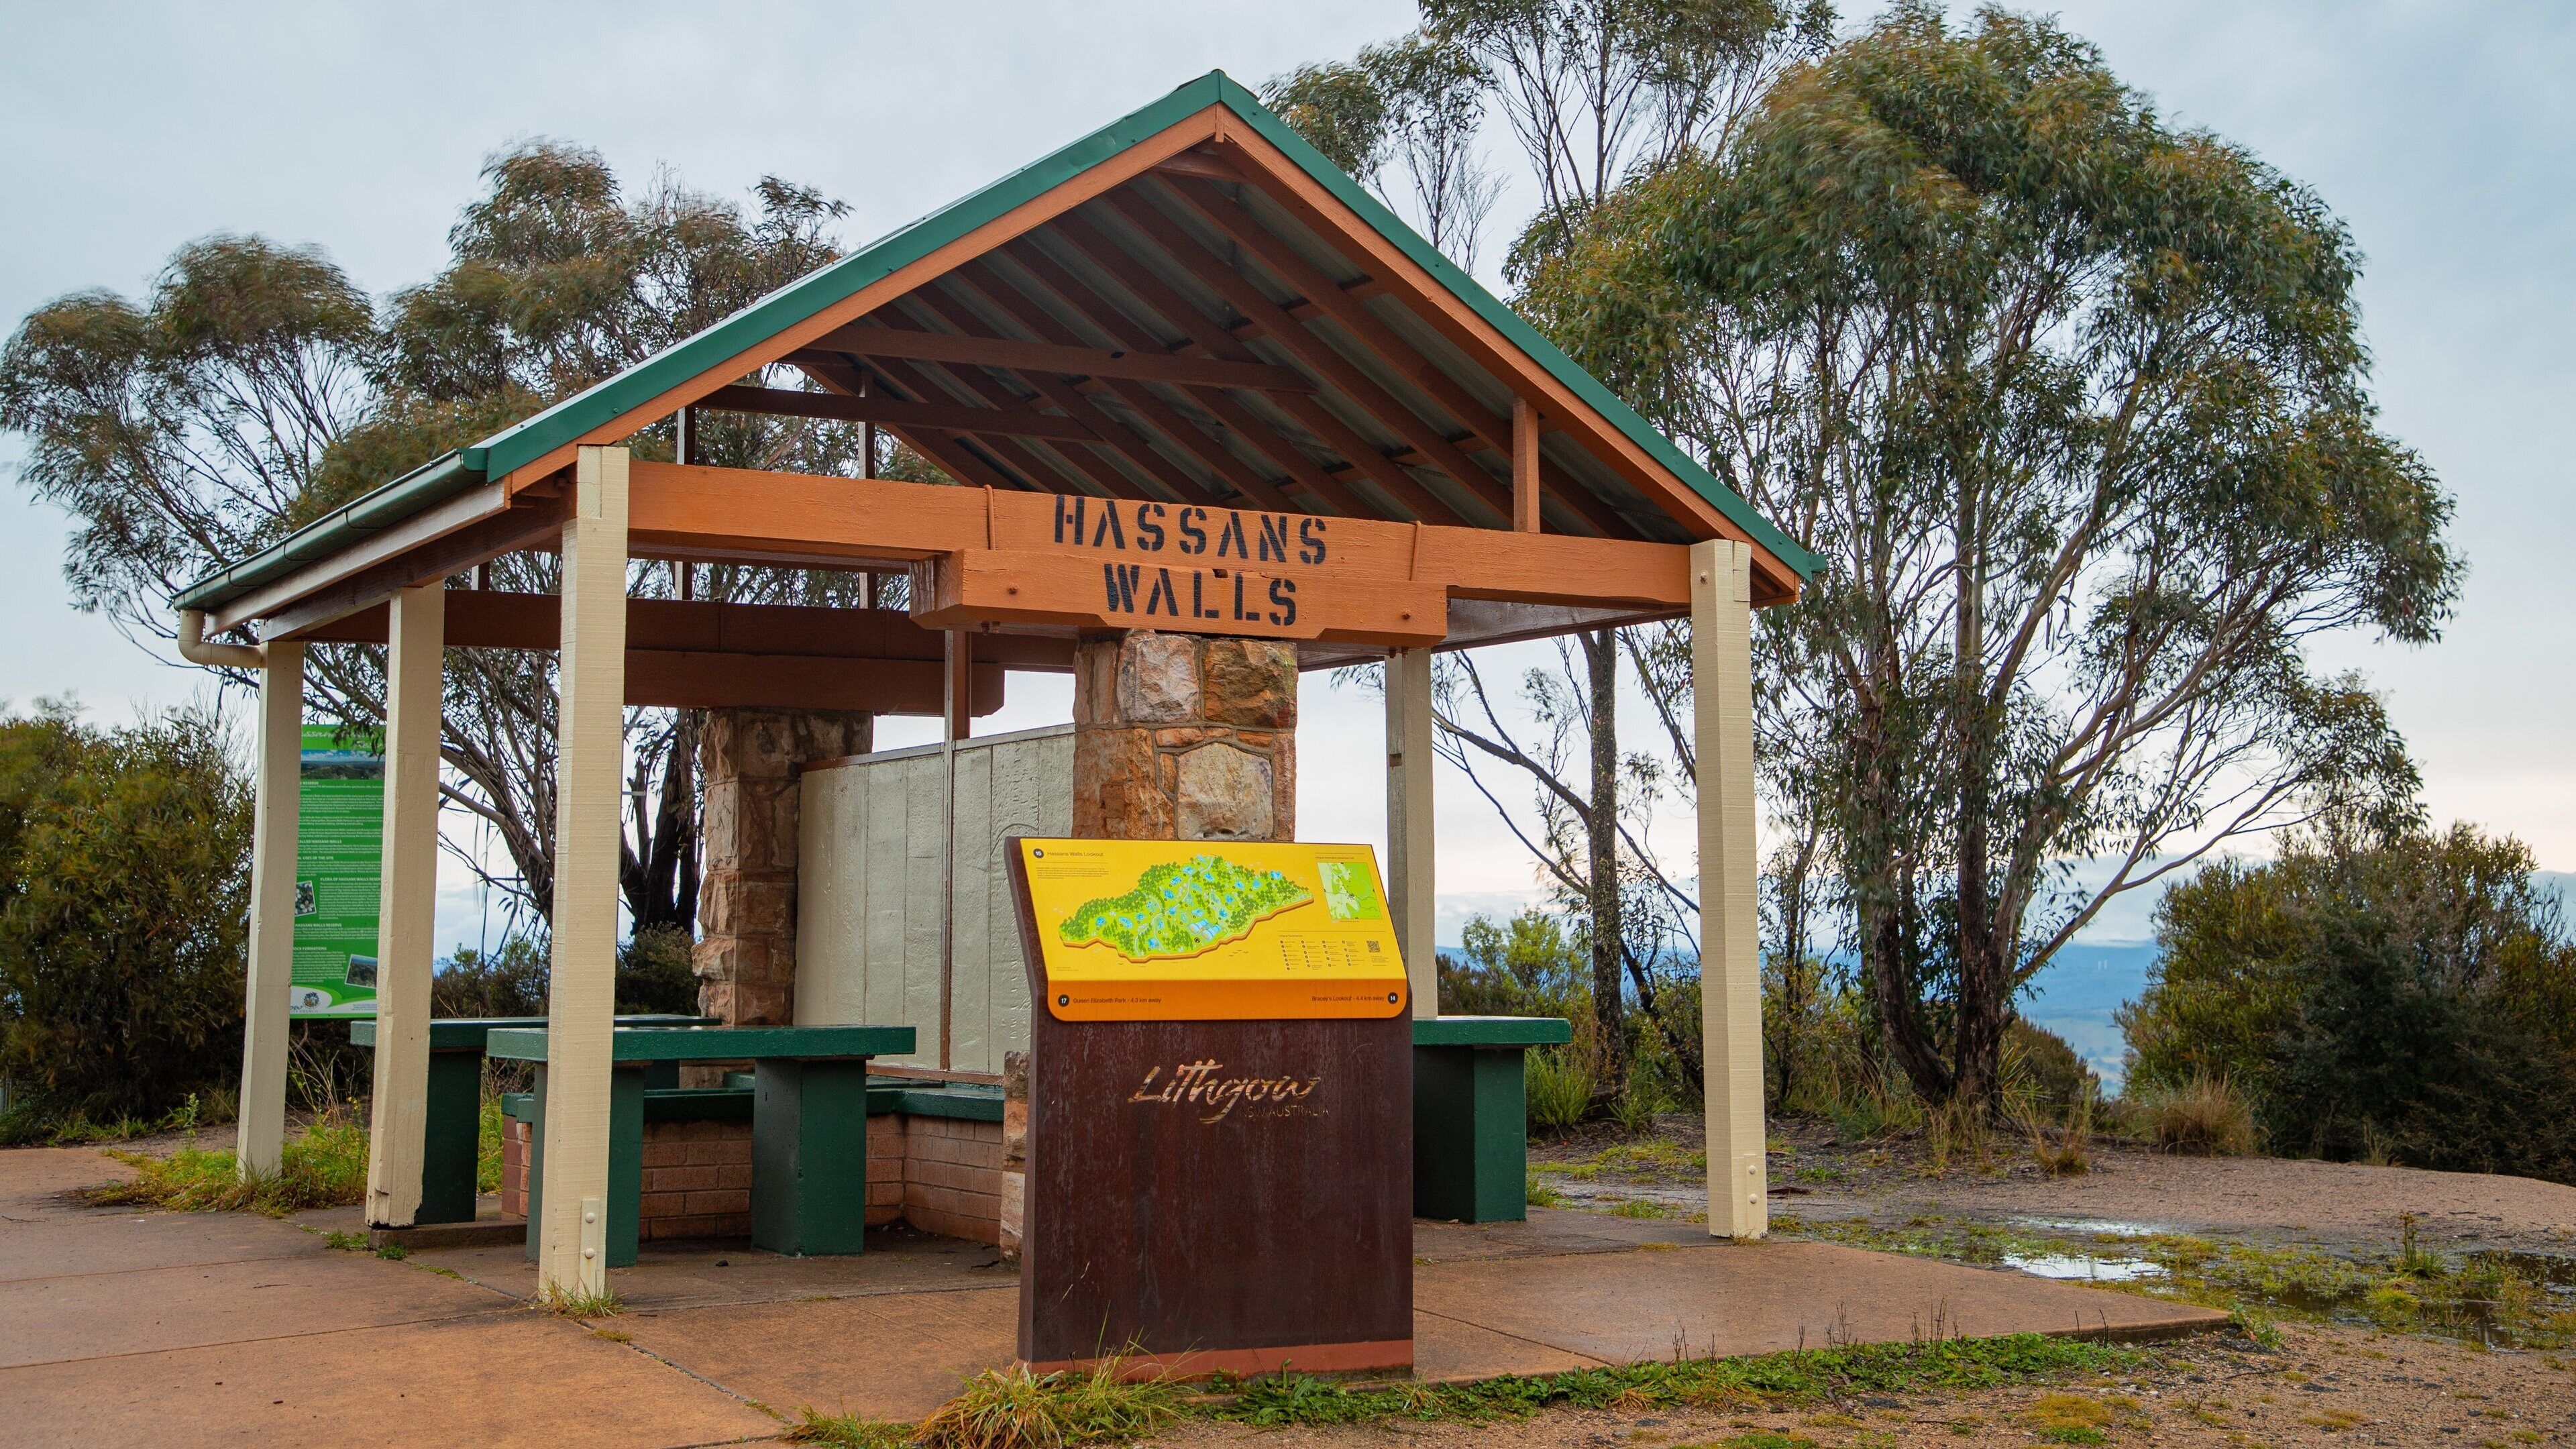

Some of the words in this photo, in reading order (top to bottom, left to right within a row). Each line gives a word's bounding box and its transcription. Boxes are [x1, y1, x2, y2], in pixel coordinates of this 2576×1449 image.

[1054, 494, 1327, 565] HASSANS
[1104, 563, 1297, 627] WALLS
[1269, 1104, 1331, 1118] AUSTRALIA
